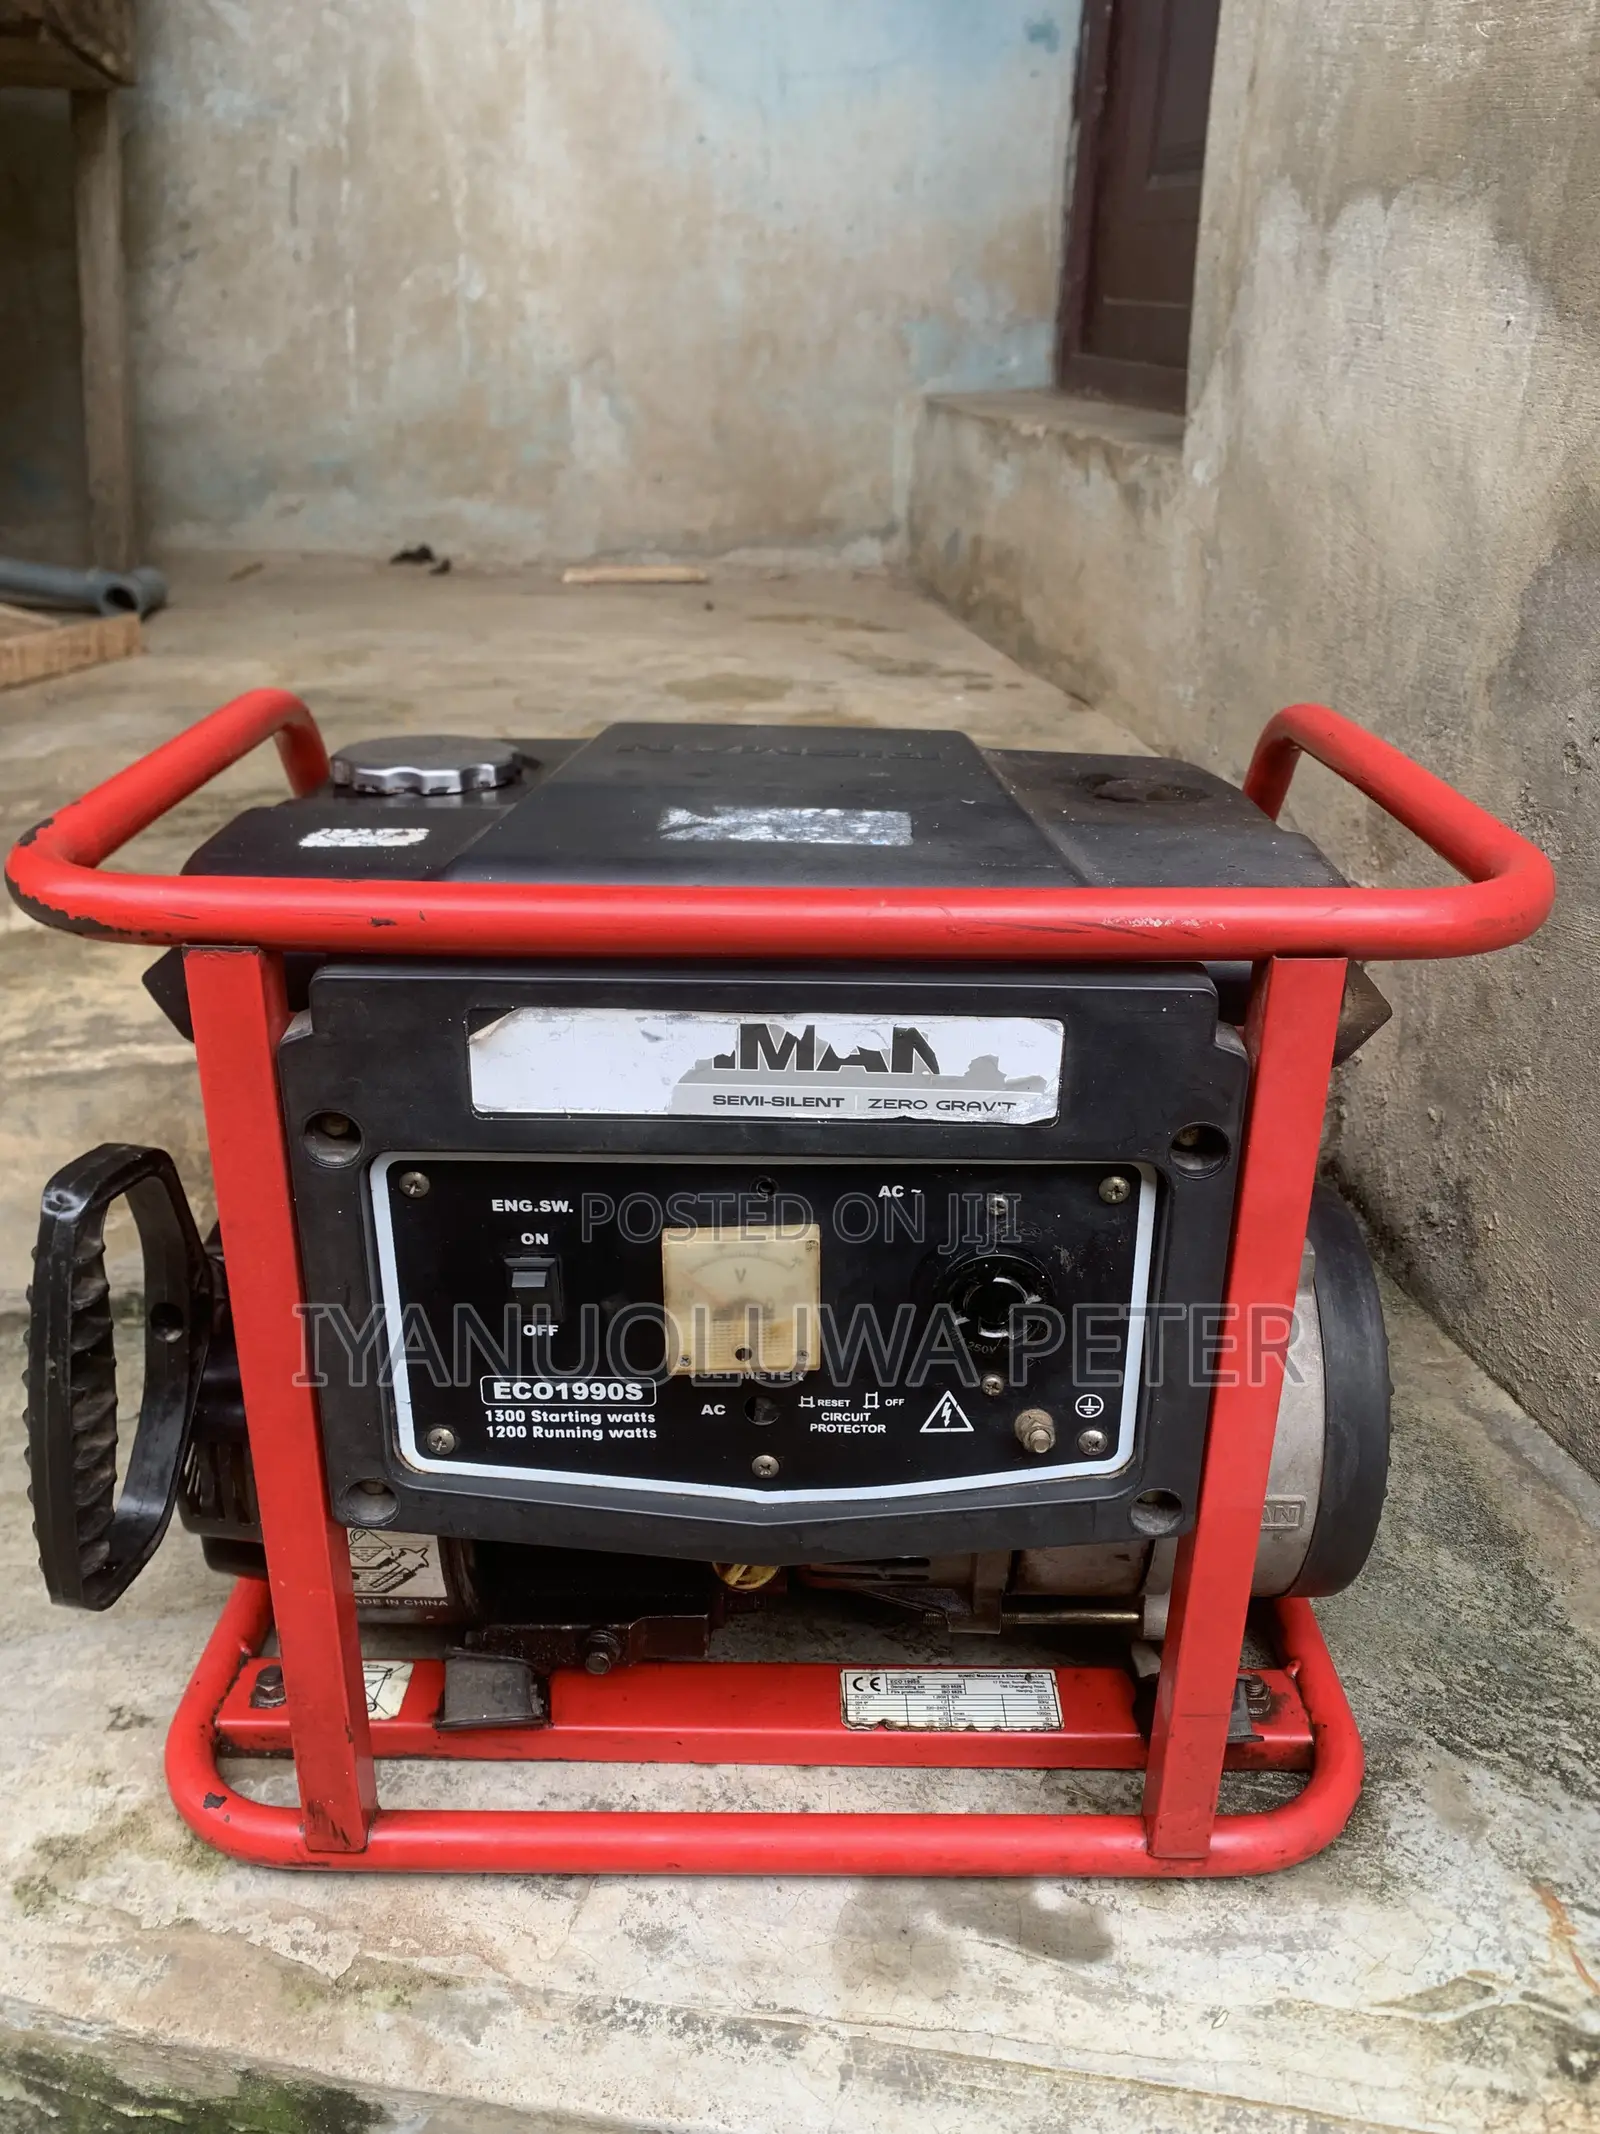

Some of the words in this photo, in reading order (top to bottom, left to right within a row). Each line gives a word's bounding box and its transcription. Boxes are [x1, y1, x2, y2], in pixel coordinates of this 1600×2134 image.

[713, 1022, 941, 1076] MAN
[712, 1094, 845, 1108] SEMI-SILENT
[867, 1098, 928, 1111] ZERO
[877, 1184, 905, 1198] AC
[491, 1198, 574, 1214] ENG.SW.
[520, 1232, 549, 1246] ON
[734, 1267, 748, 1284] V
[522, 1323, 559, 1337] OFF
[740, 1370, 804, 1382] METER
[493, 1381, 644, 1401] ECO1990S
[700, 1404, 727, 1416] AC
[817, 1398, 851, 1408] RESET
[885, 1398, 905, 1408] OFF
[485, 1409, 526, 1423] 1300
[531, 1409, 602, 1425] Starting
[607, 1411, 656, 1424] watts
[820, 1411, 872, 1422] CIRCUIT
[485, 1425, 527, 1439] 1200
[532, 1425, 604, 1441] Running
[608, 1426, 658, 1439] watts
[809, 1422, 887, 1434] PROTECTOR
[403, 1599, 449, 1607] CHINA
